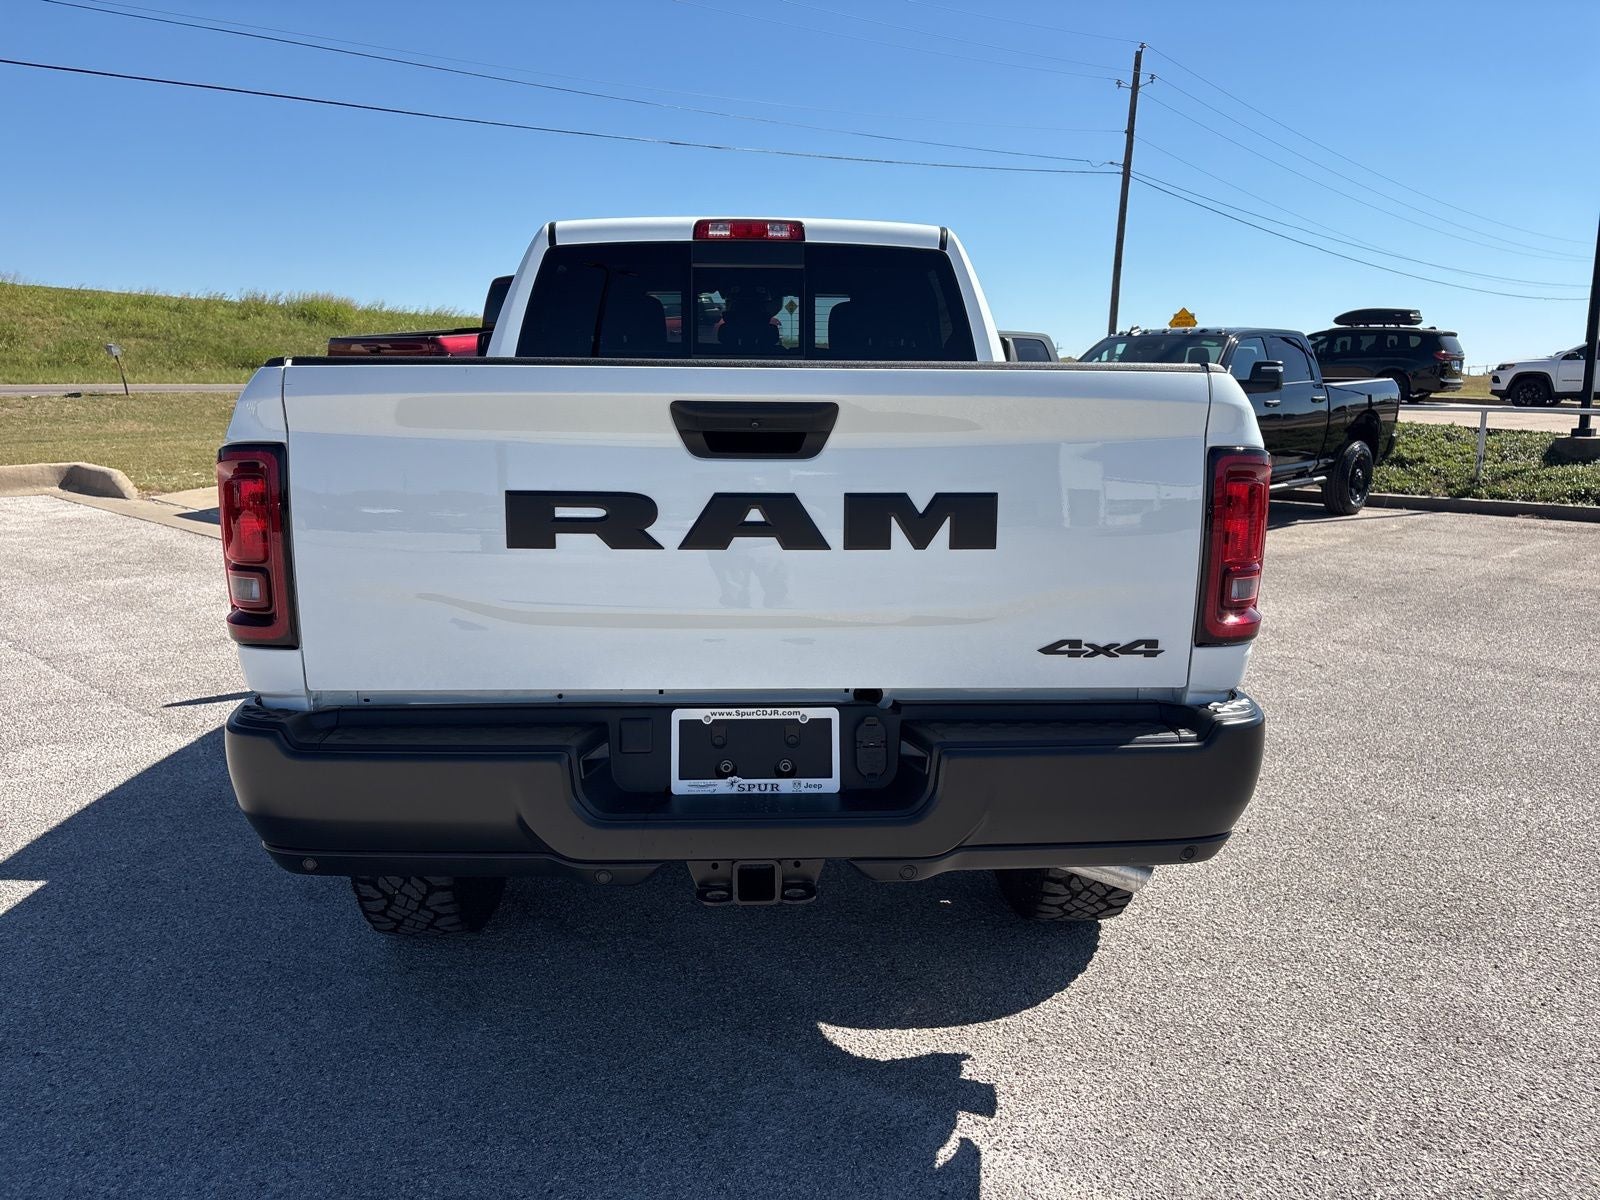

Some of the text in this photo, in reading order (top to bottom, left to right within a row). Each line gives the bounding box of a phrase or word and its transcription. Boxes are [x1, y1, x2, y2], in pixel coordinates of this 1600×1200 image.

[504, 489, 999, 551] RAM
[1037, 639, 1165, 658] 4x4
[710, 709, 801, 718] www.SpurCDJR.com
[737, 783, 780, 793] SPUR
[803, 782, 823, 790] Jeep
